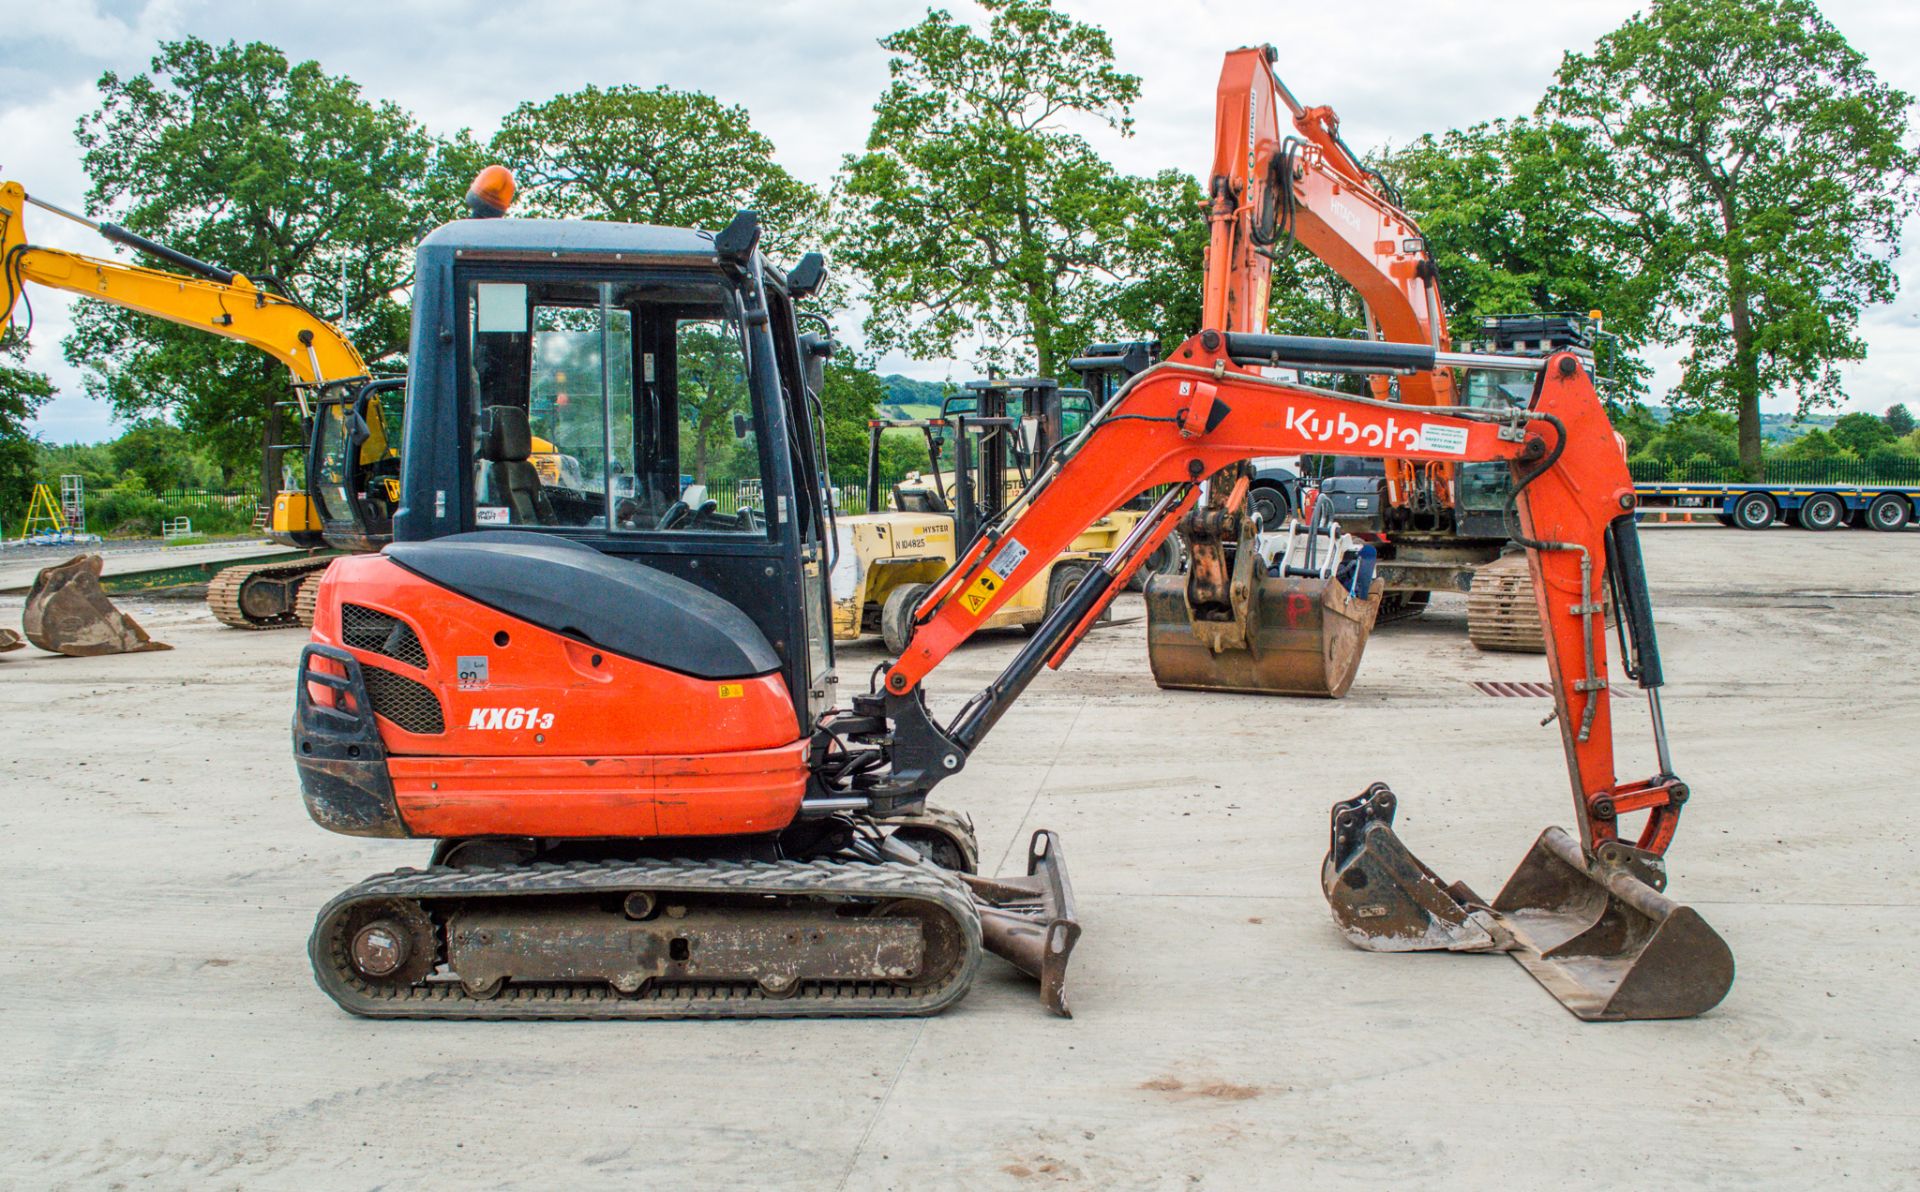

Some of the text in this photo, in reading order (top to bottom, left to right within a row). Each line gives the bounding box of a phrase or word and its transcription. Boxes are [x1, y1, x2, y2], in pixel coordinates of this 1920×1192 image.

[1331, 197, 1360, 232] HITACHI
[1285, 406, 1420, 451] Kubota
[922, 524, 949, 533] HYSTER
[468, 706, 555, 731] KX61-3
